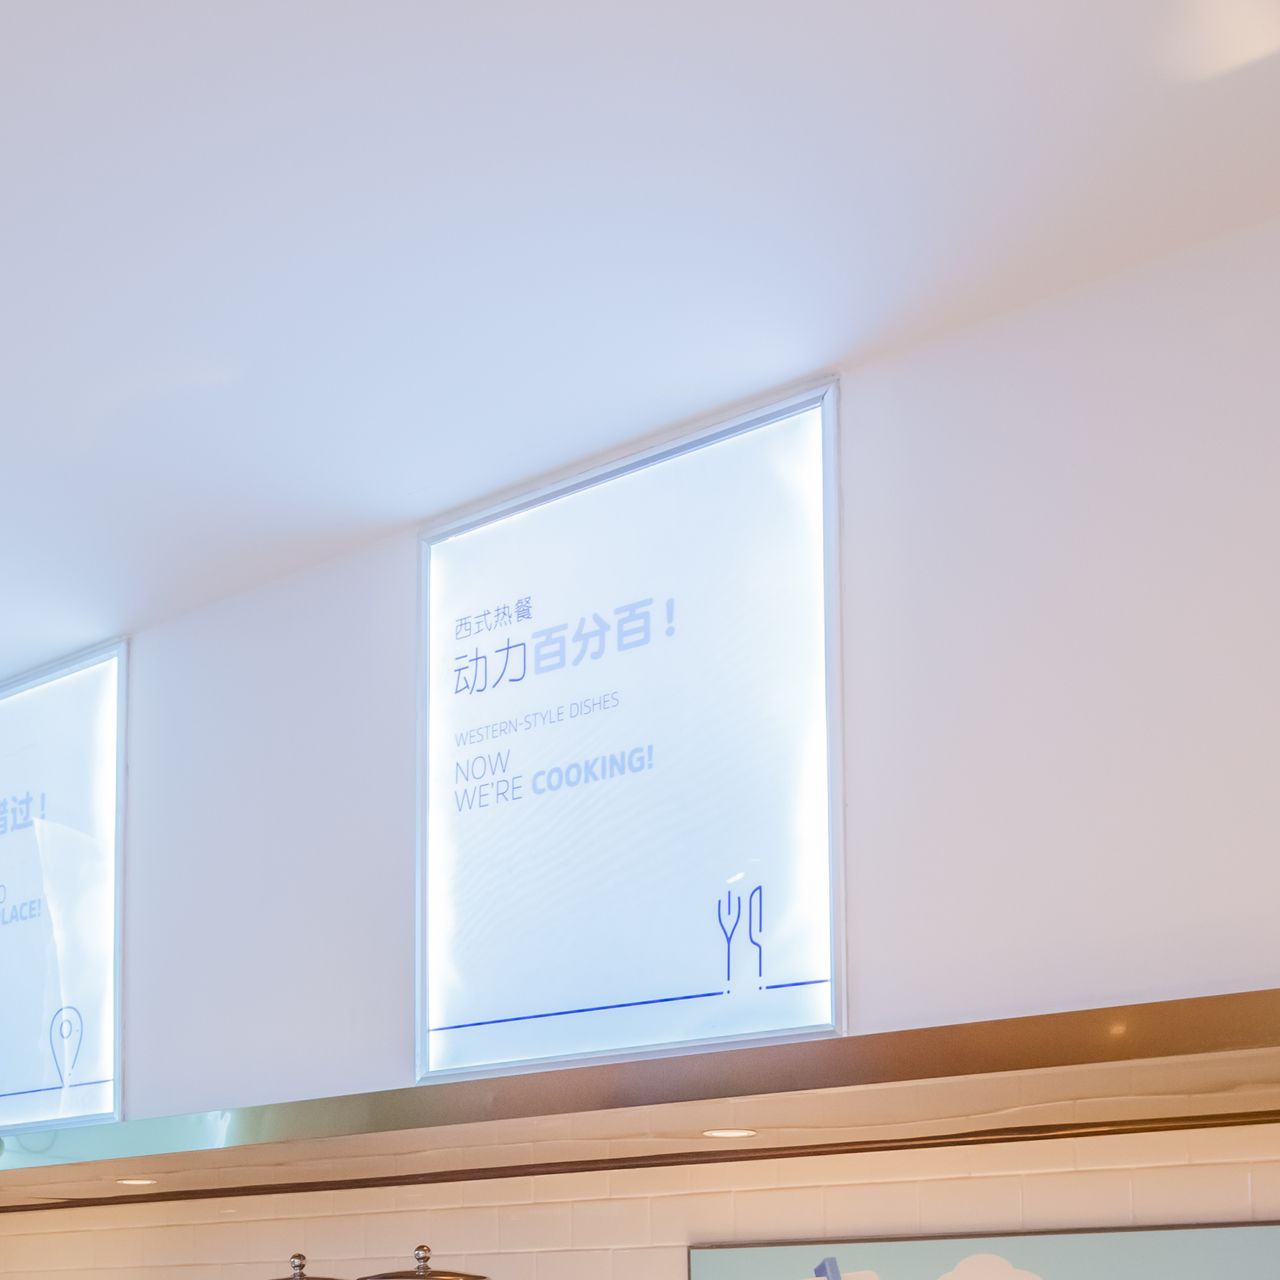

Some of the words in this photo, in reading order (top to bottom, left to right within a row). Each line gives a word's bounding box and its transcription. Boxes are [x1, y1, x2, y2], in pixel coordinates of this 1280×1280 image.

[453, 597, 677, 695] 动力百分百！
[455, 596, 533, 640] 西式热餐
[455, 705, 564, 747] WESTERN-STYLE
[569, 691, 620, 719] DISHES
[454, 775, 523, 812] WE'RE
[531, 744, 654, 795] COOKING!
[455, 749, 511, 784] NOW
